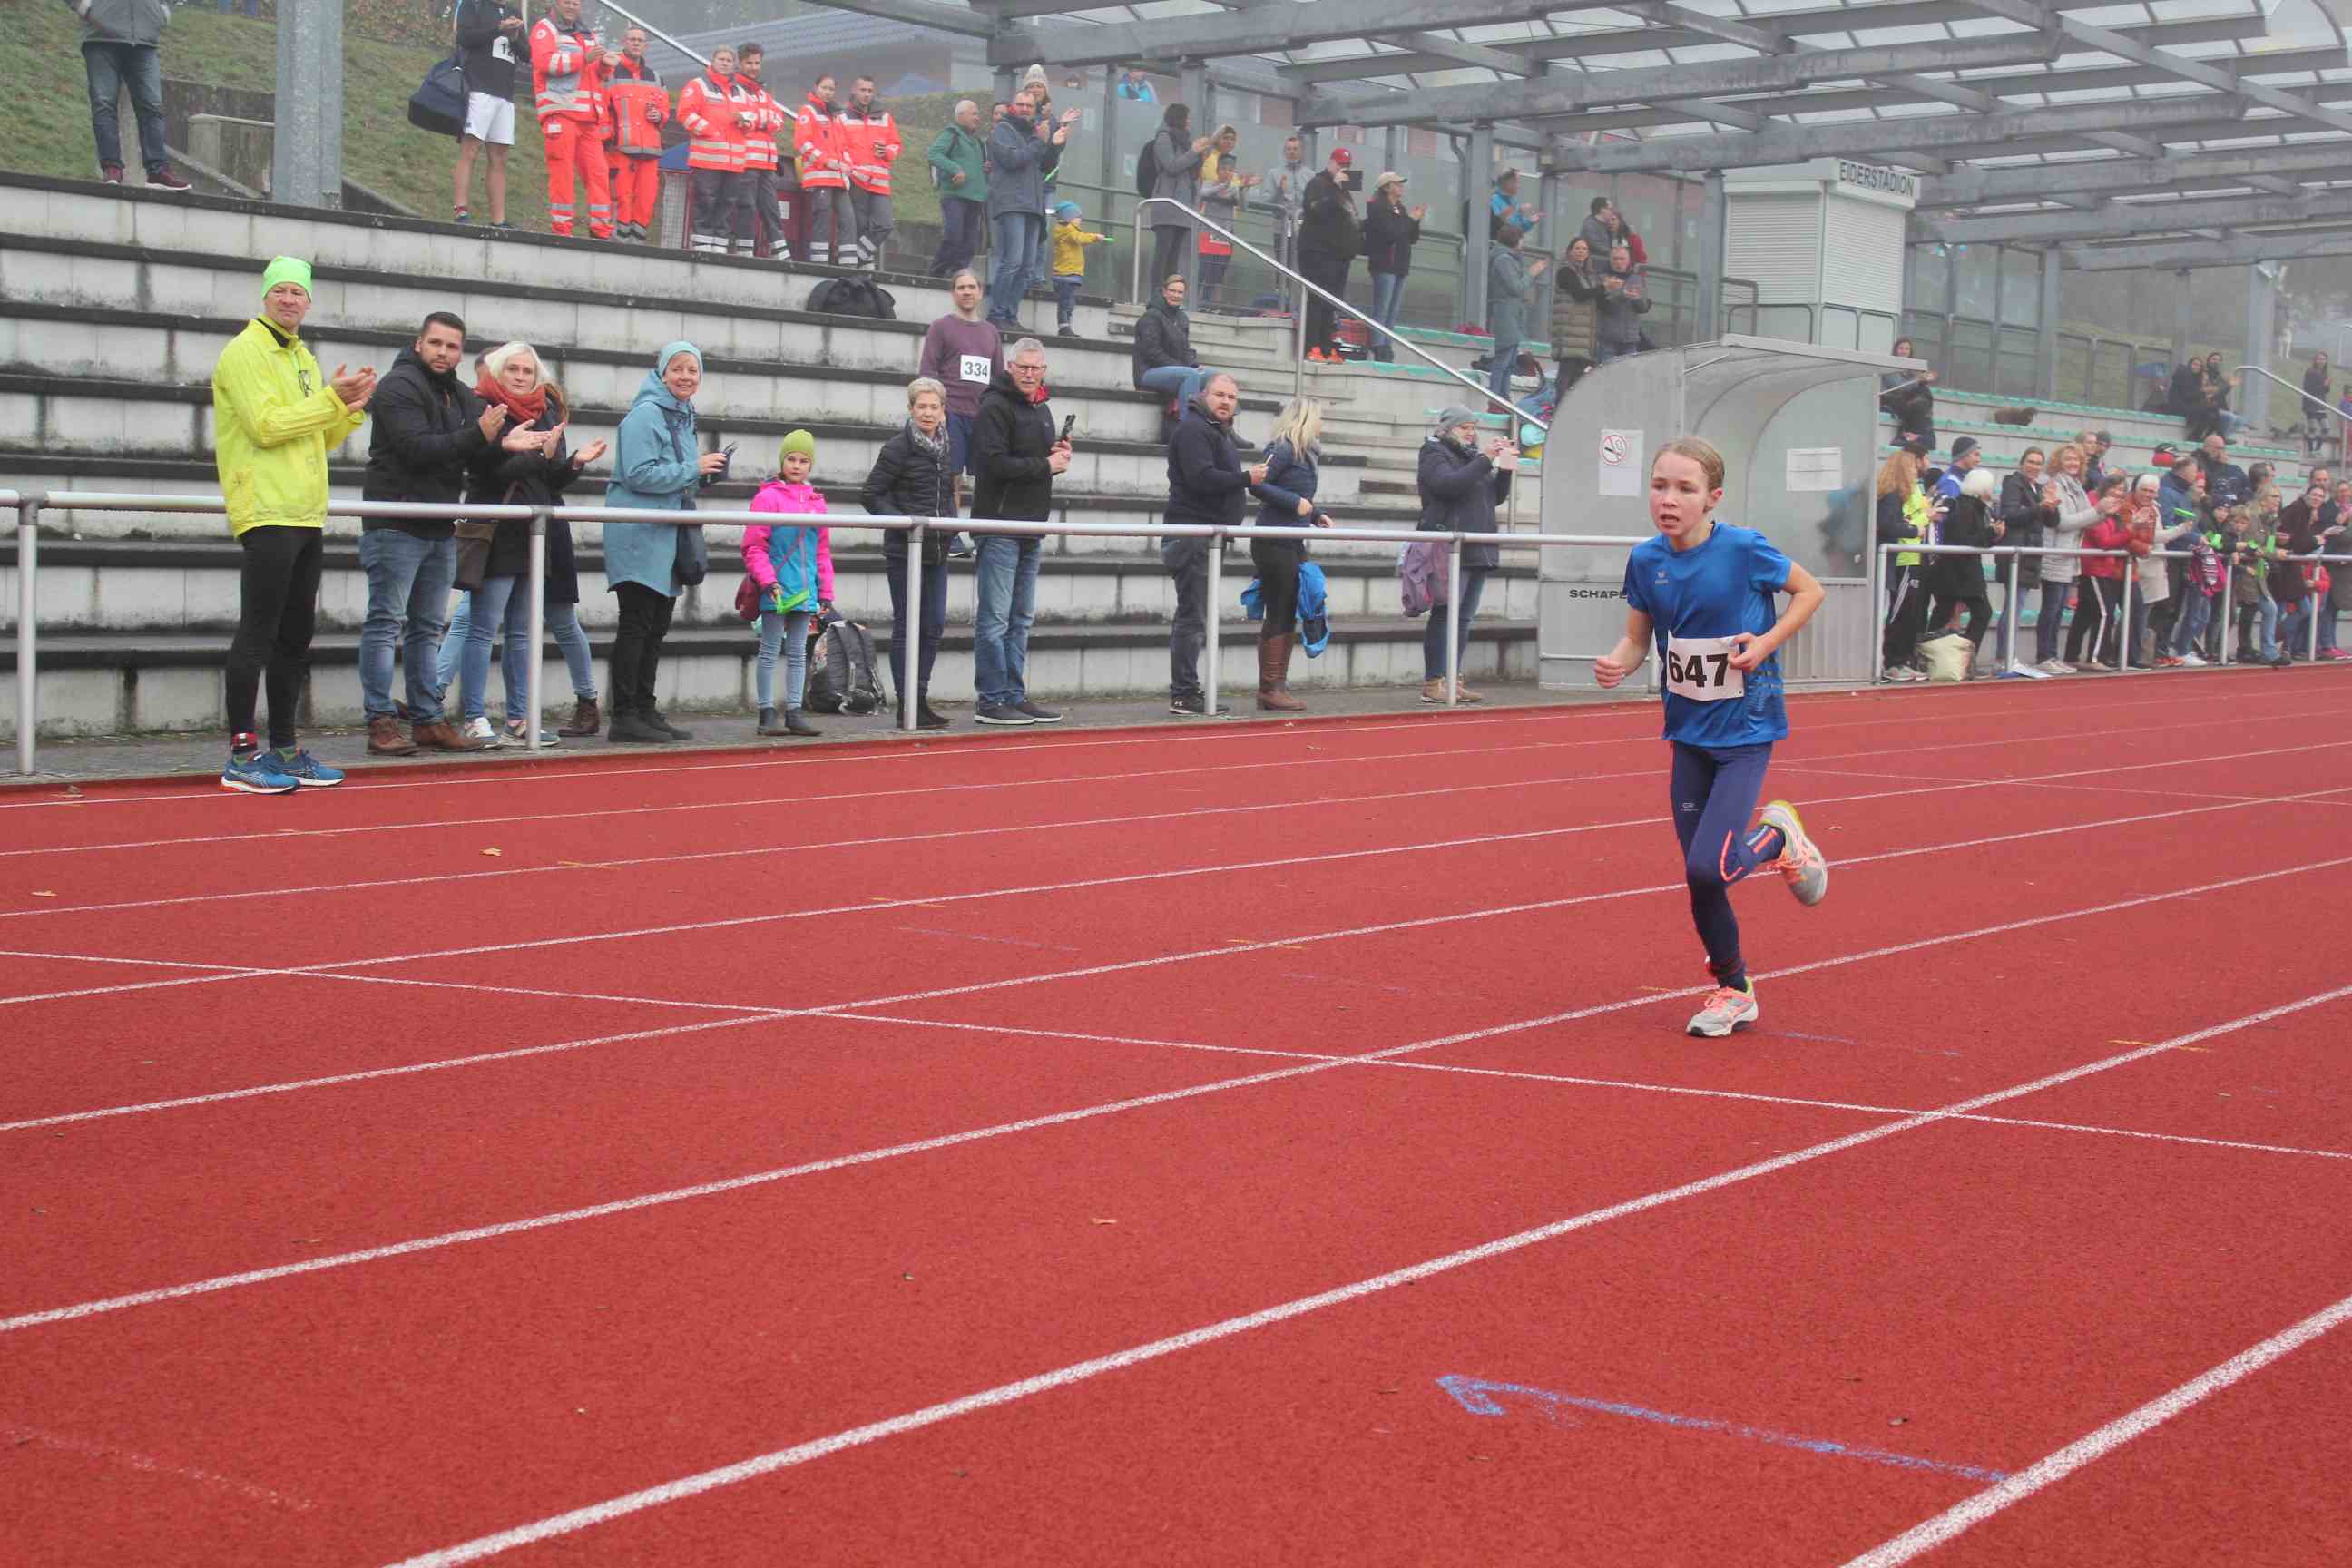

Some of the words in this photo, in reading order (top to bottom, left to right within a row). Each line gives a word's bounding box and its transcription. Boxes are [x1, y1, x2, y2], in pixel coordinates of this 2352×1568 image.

[1839, 161, 1914, 196] EIDERSTADION
[965, 361, 987, 377] 334
[1668, 649, 1728, 688] 647
